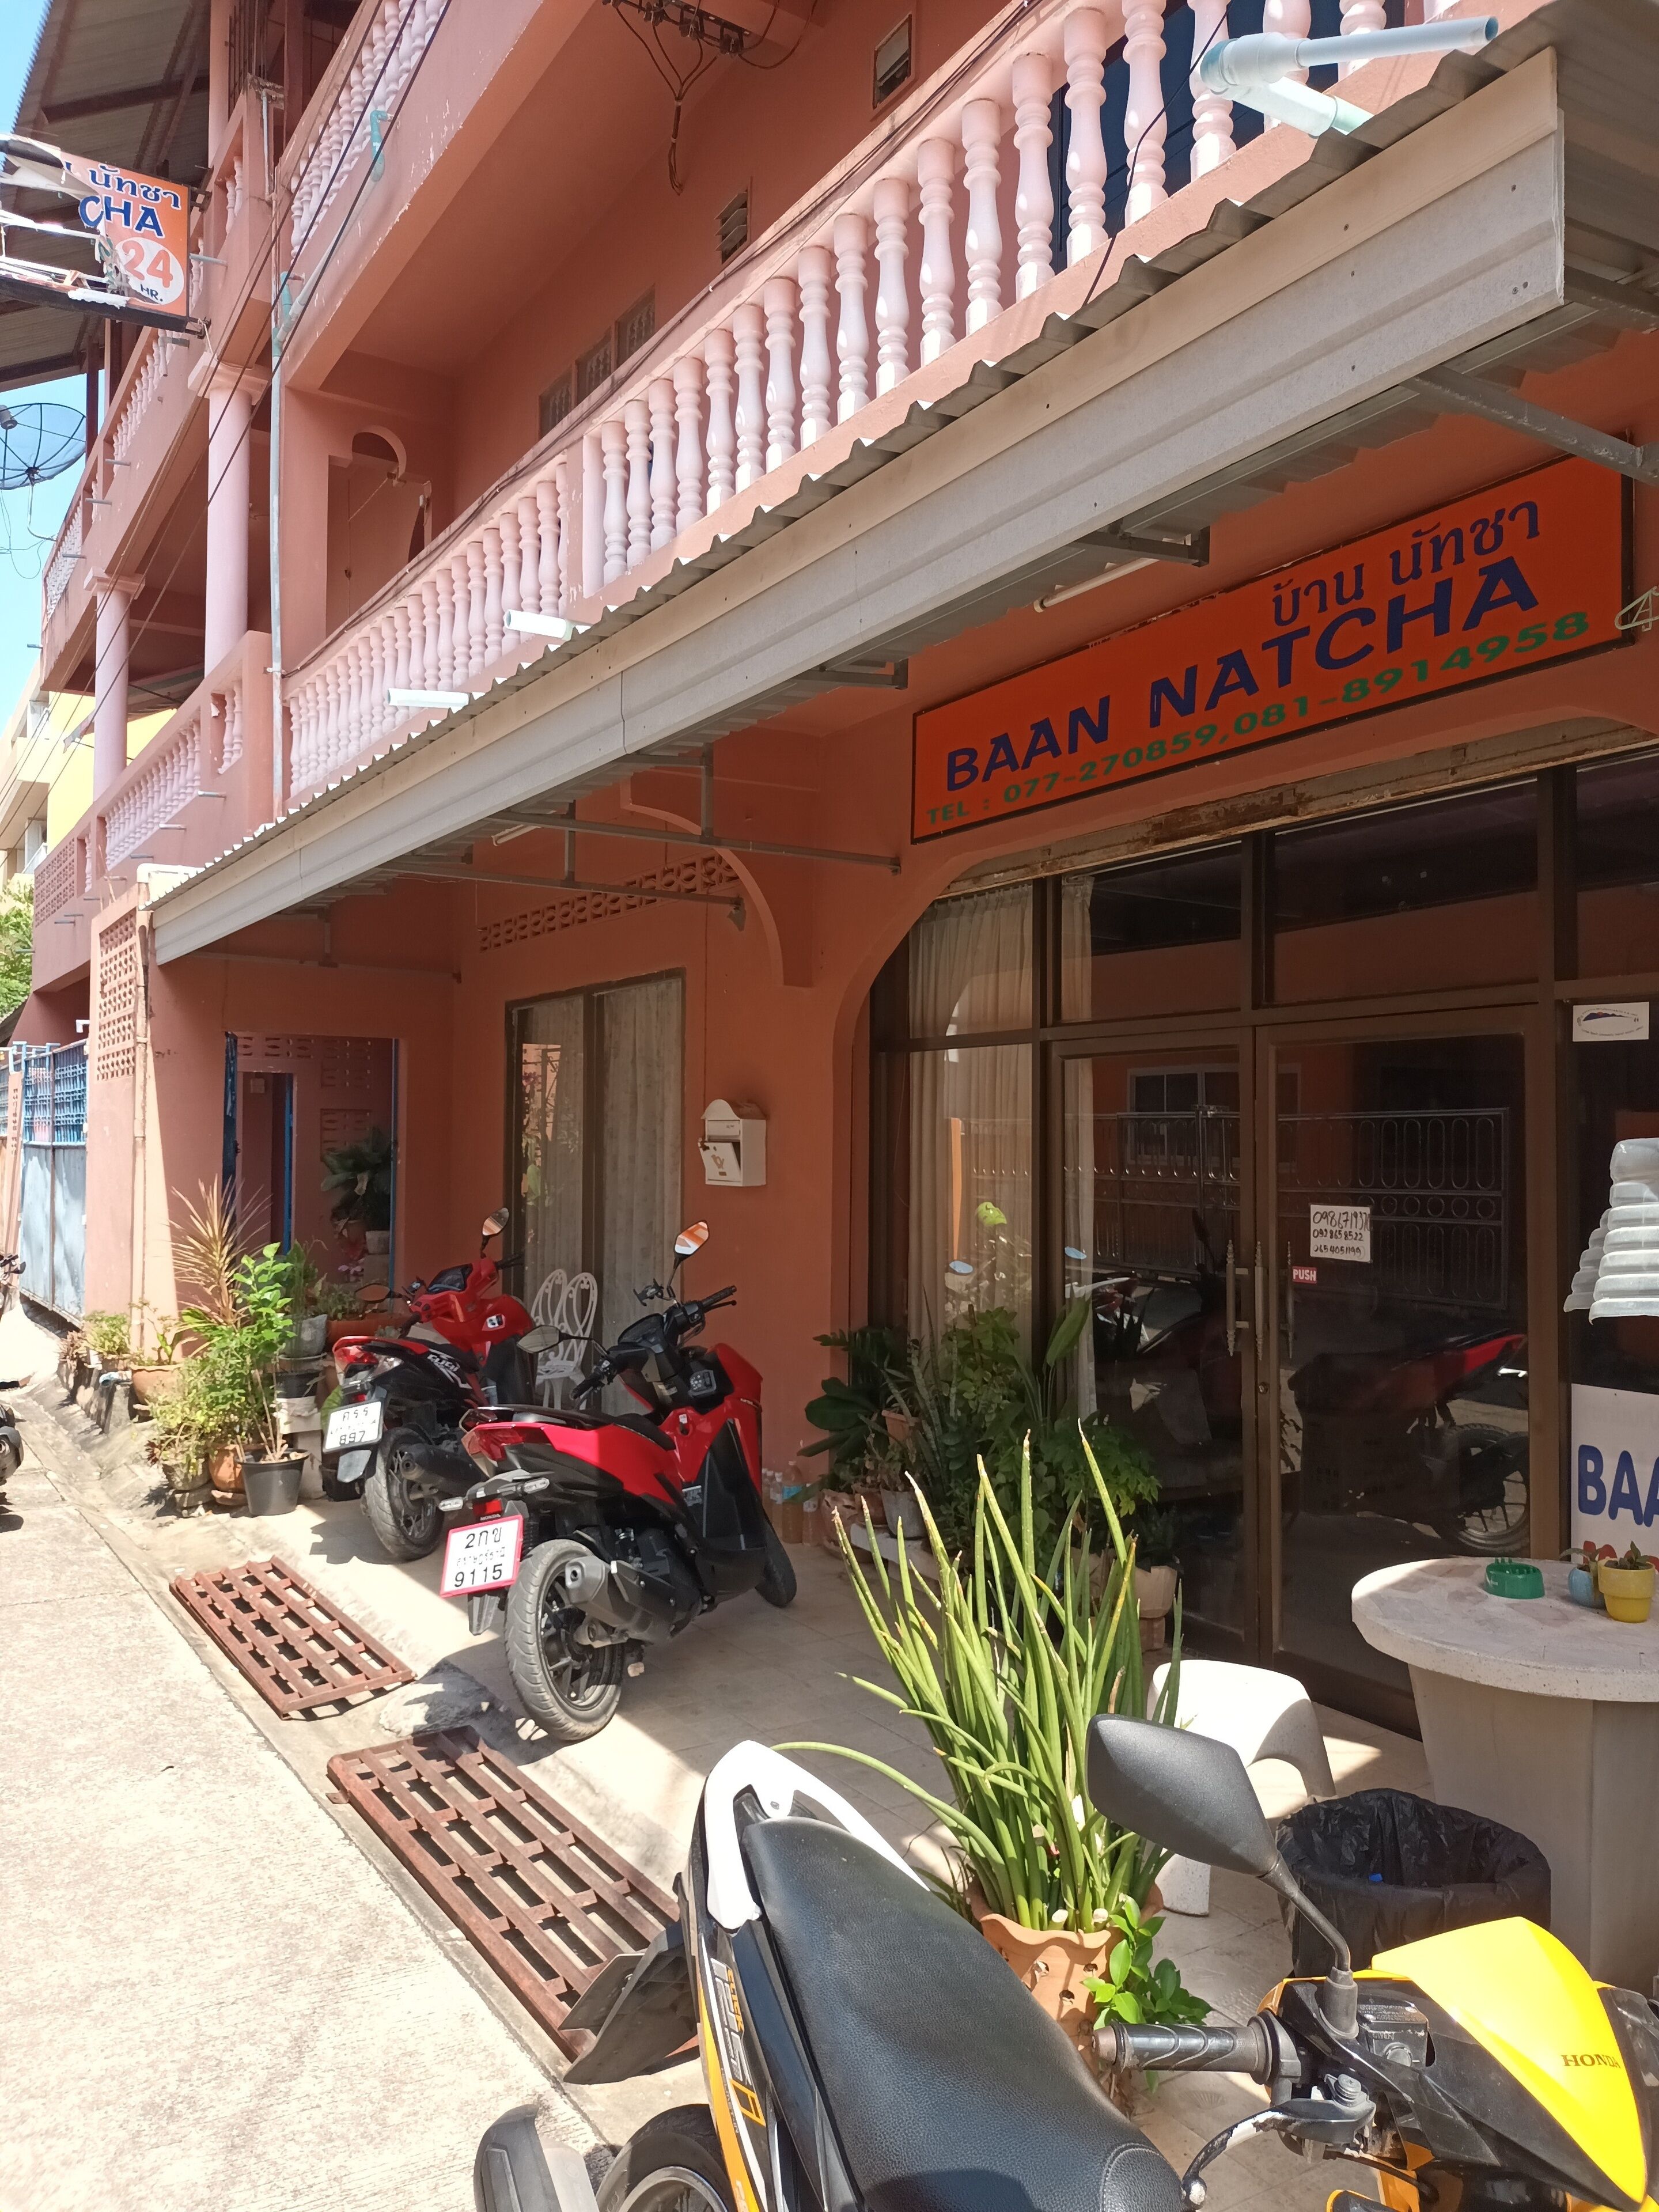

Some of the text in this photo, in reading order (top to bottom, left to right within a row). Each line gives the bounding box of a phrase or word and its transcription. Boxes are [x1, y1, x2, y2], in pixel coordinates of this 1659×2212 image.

[89, 164, 180, 209] นัทชา
[122, 240, 173, 288] 24
[1272, 500, 1540, 627] บ้าน นัทชา
[947, 555, 1539, 791] BAAN NATCHA
[1293, 1269, 1317, 1281] PUSH
[339, 1430, 366, 1445] 897
[454, 1563, 502, 1588] 9115
[1560, 2054, 1621, 2069] HONDA
